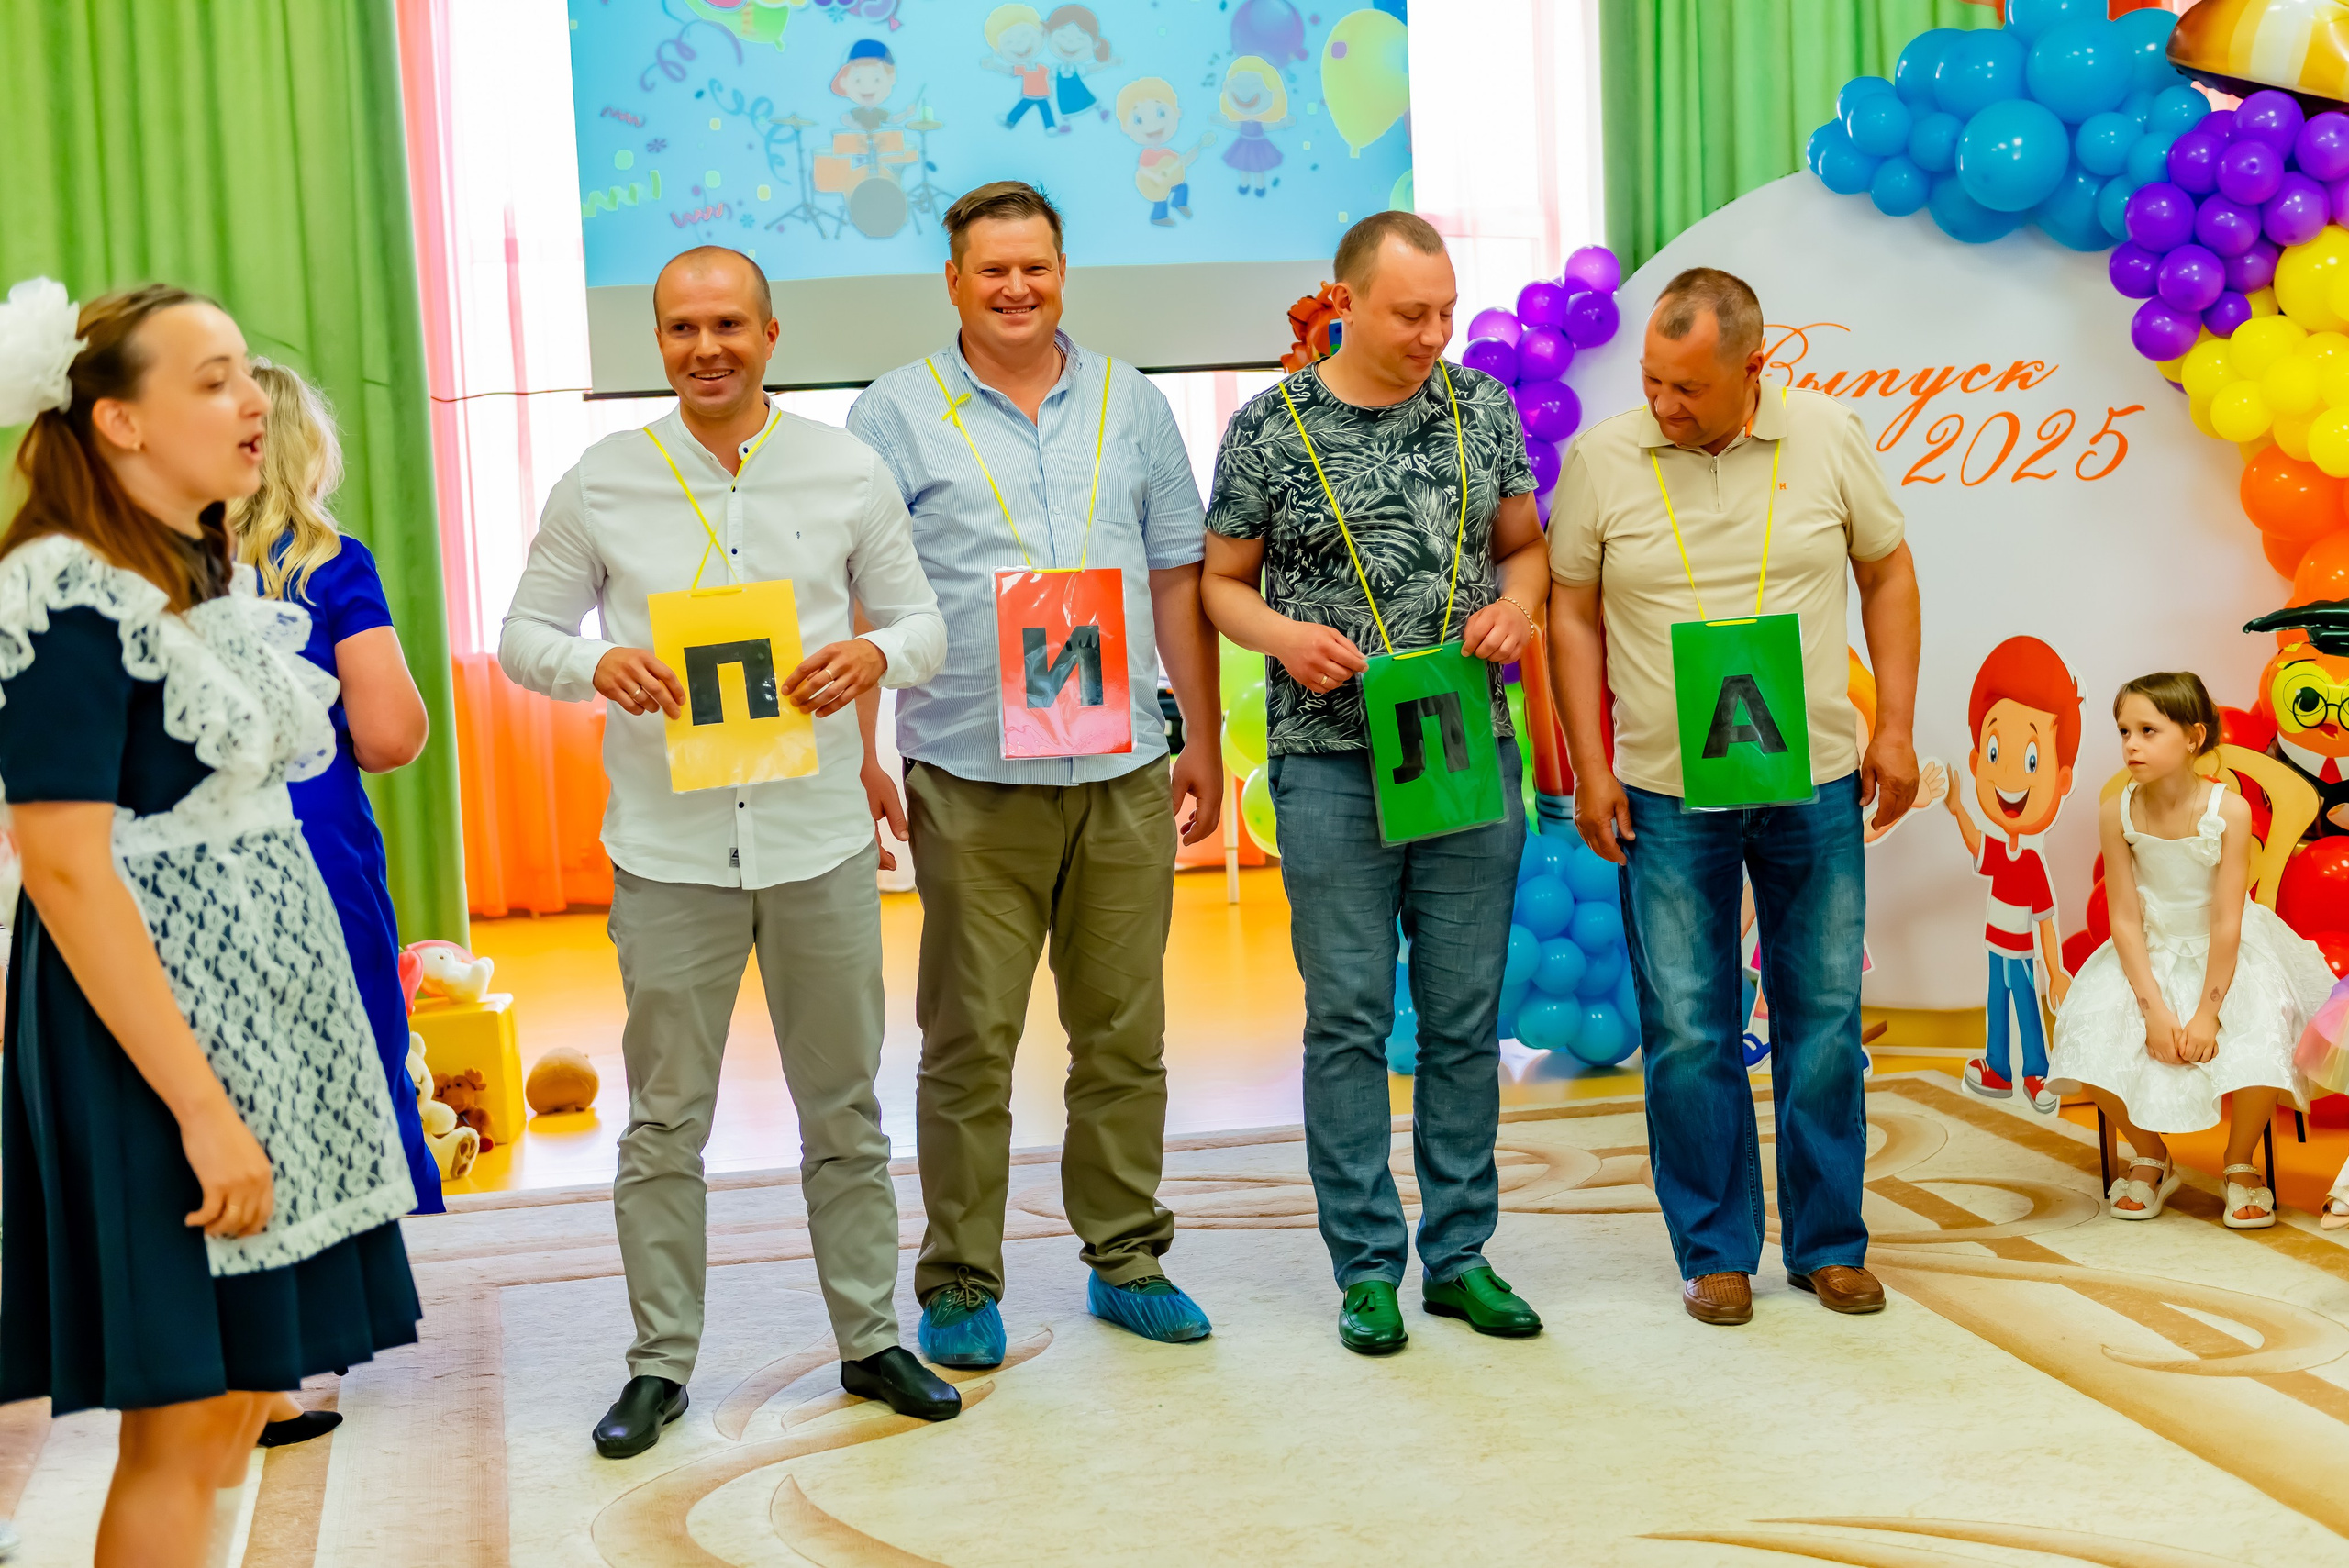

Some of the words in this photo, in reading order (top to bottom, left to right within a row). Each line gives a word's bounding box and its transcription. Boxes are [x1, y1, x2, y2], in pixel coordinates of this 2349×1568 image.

[1761, 322, 2059, 452] Выпуск
[1901, 404, 2146, 487] 2025
[683, 637, 780, 726] П
[1021, 624, 1104, 709] И
[1392, 690, 1471, 784] Л
[1701, 674, 1789, 759] А
